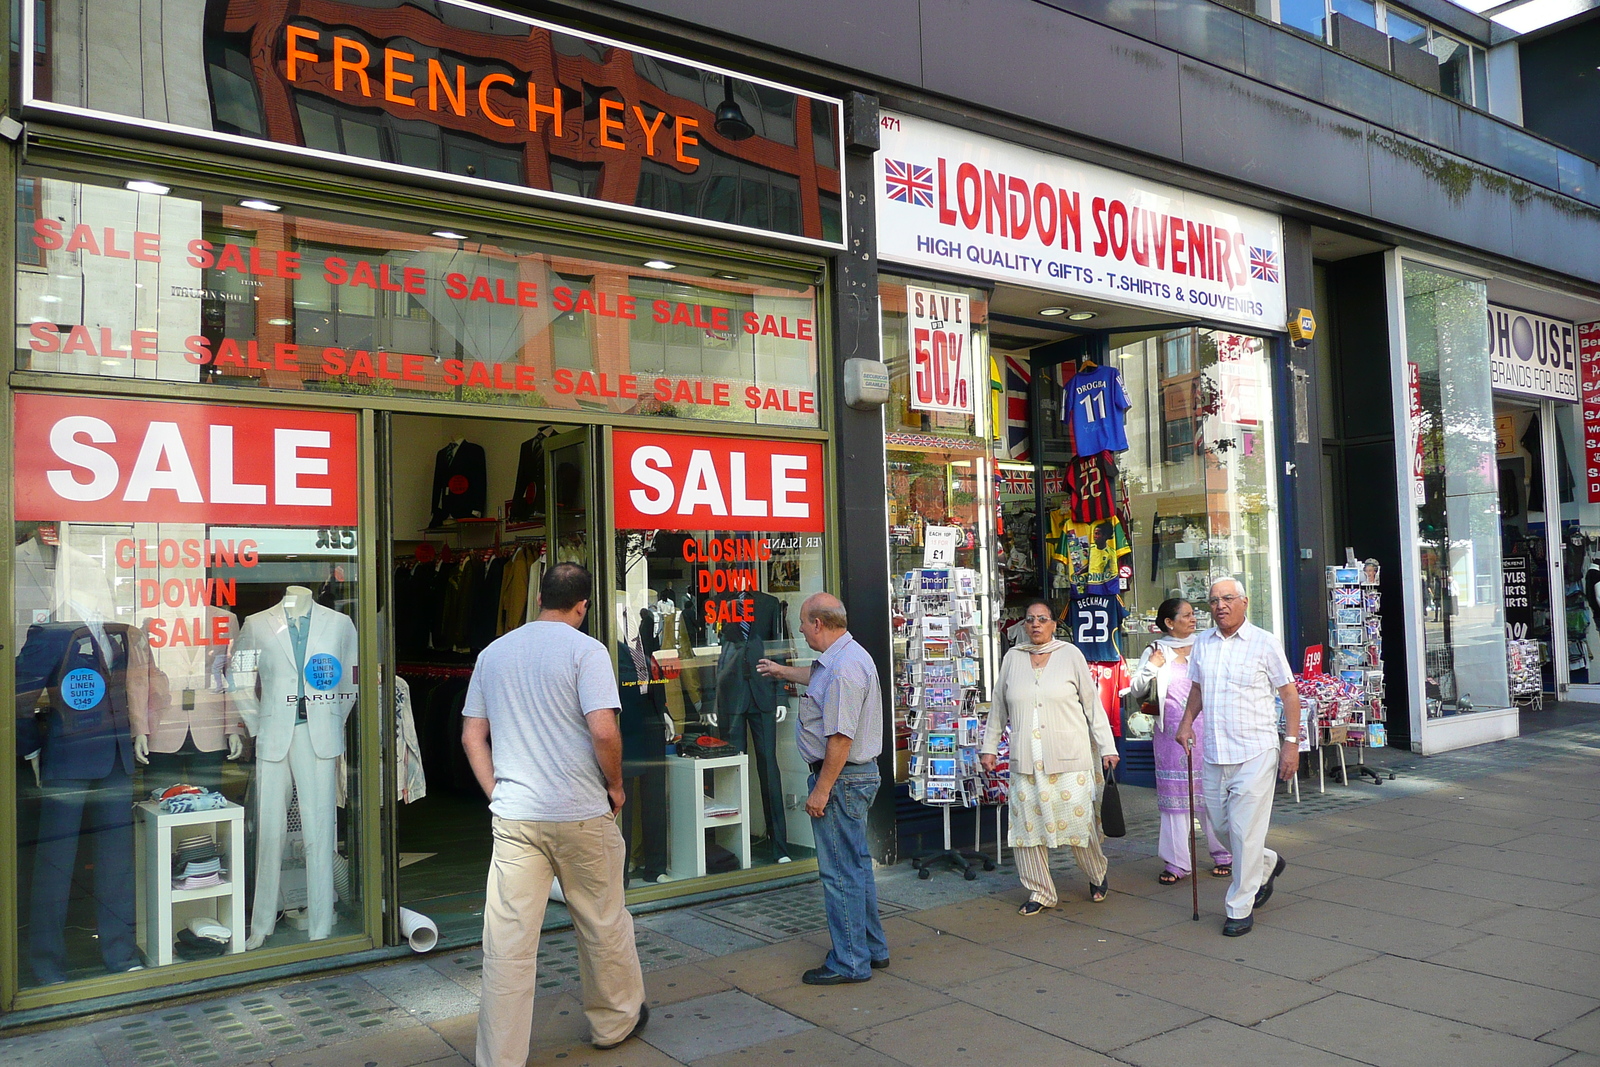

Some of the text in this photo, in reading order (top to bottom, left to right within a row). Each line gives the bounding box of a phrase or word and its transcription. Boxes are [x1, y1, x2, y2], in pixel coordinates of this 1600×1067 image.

[285, 24, 701, 167] FRENCH EYE
[880, 116, 902, 133] 471
[937, 156, 1247, 292] LONDON SOUVENIRS
[31, 217, 813, 342] SALE SALE SALE SALE SALE SALE SALE
[916, 235, 962, 260] HIGH
[966, 244, 1043, 279] QUALITY
[1047, 260, 1094, 285] GIFTS
[1106, 273, 1171, 301] T.SHIRTS
[1175, 287, 1185, 301] &
[1188, 288, 1263, 317] SOUVENIRS
[914, 291, 963, 324] SAVE
[28, 321, 815, 414] SALE SALE SALE SALE SALE SALE SALE
[914, 327, 968, 408] 50%
[1491, 360, 1576, 396] BRANDS FOR LESS
[1076, 380, 1107, 395] DROGBA
[1079, 390, 1106, 423] 11
[46, 415, 333, 507] SALE
[629, 445, 810, 518] SALE
[1079, 467, 1102, 500] 22
[115, 538, 259, 570] CLOSING
[682, 538, 772, 562] CLOSING
[932, 549, 944, 560] £1
[139, 577, 237, 608] DOWN
[699, 569, 758, 593] DOWN
[704, 599, 755, 624] SALE
[1077, 596, 1109, 609] BECKHAM
[148, 616, 231, 649] SALE
[1078, 610, 1109, 643] 23
[70, 682, 95, 690] LINEN
[286, 692, 358, 703] BARUTTI
